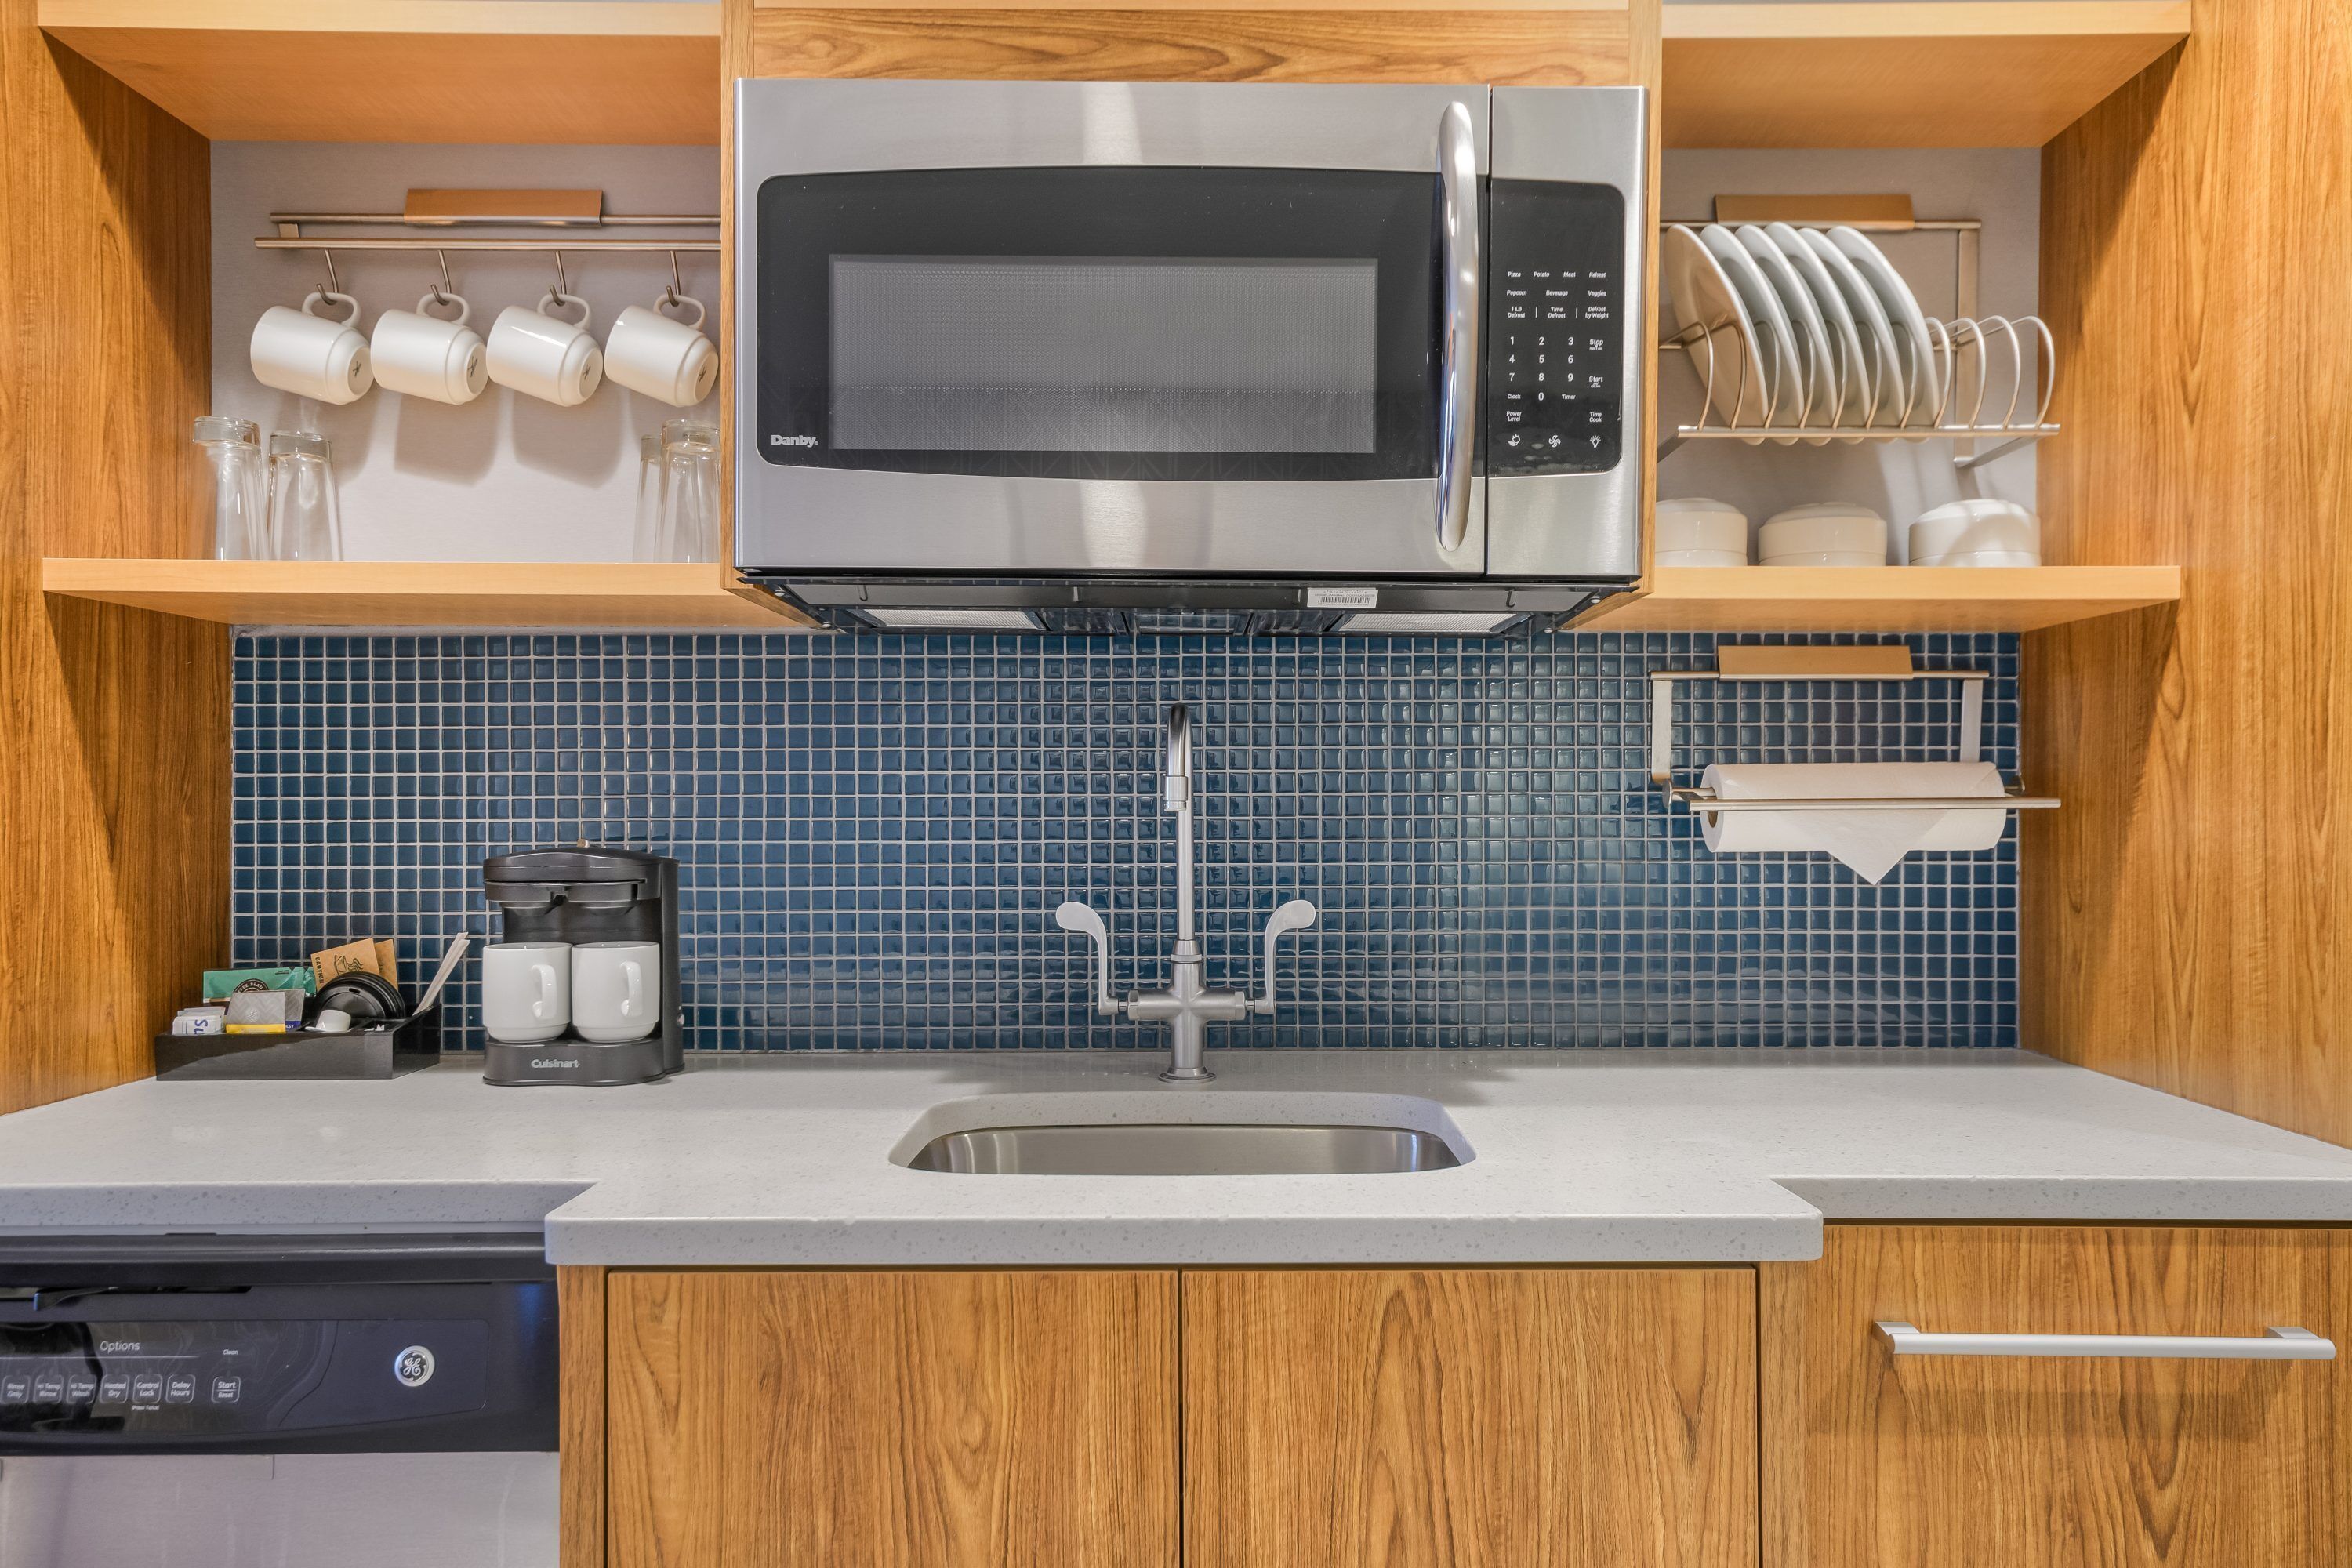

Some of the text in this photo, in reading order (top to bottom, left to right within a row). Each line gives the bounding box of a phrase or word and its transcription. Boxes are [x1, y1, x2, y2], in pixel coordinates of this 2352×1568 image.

[1510, 336, 1515, 345] 1
[314, 956, 325, 984] CAUTION
[531, 1058, 580, 1068] Cuisinart
[100, 1341, 140, 1353] Options
